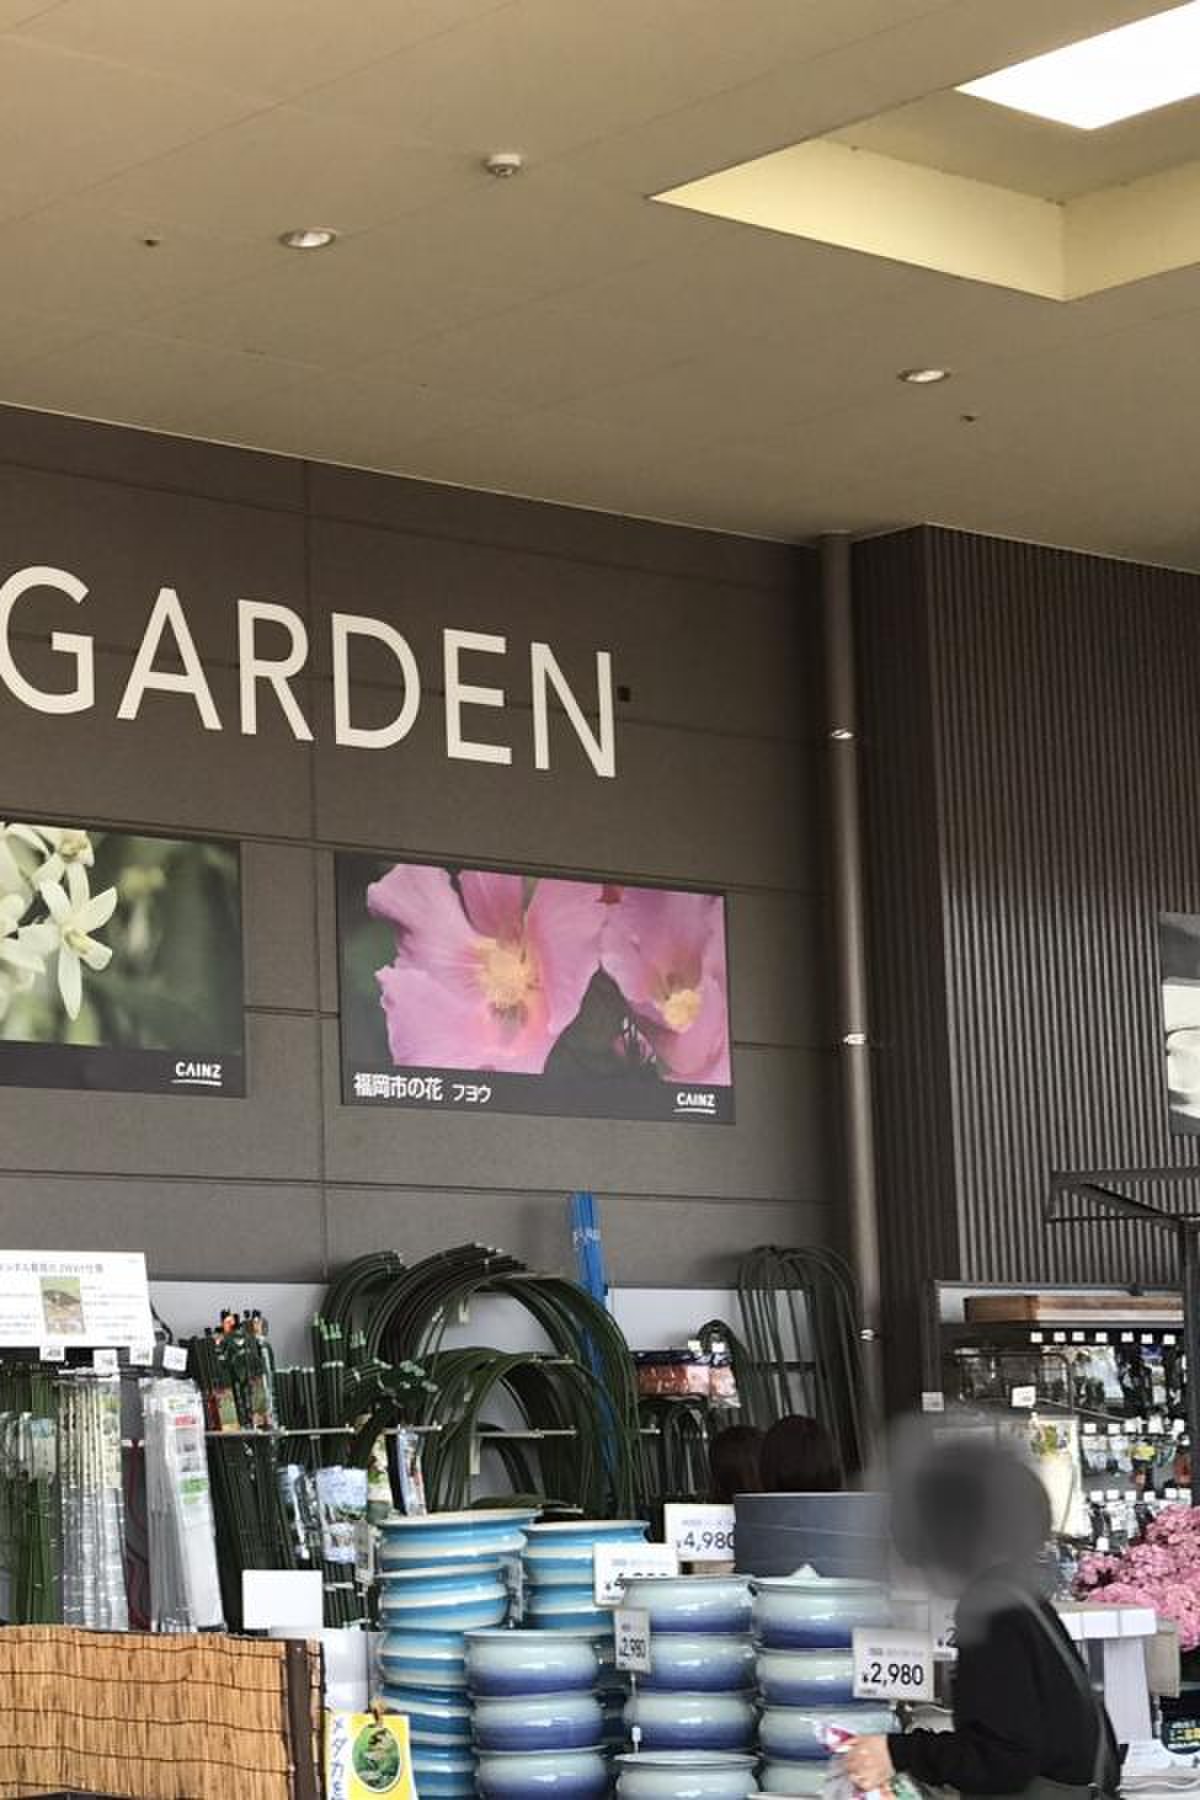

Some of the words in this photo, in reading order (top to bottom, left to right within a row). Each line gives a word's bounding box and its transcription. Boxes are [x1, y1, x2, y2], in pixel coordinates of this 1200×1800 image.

[175, 1060, 222, 1079] CAINZ
[353, 1072, 443, 1101] 福岡市の花
[451, 1083, 492, 1103] フヨウ
[676, 1091, 716, 1108] CAINZ
[863, 1661, 925, 1687] ¥2,980
